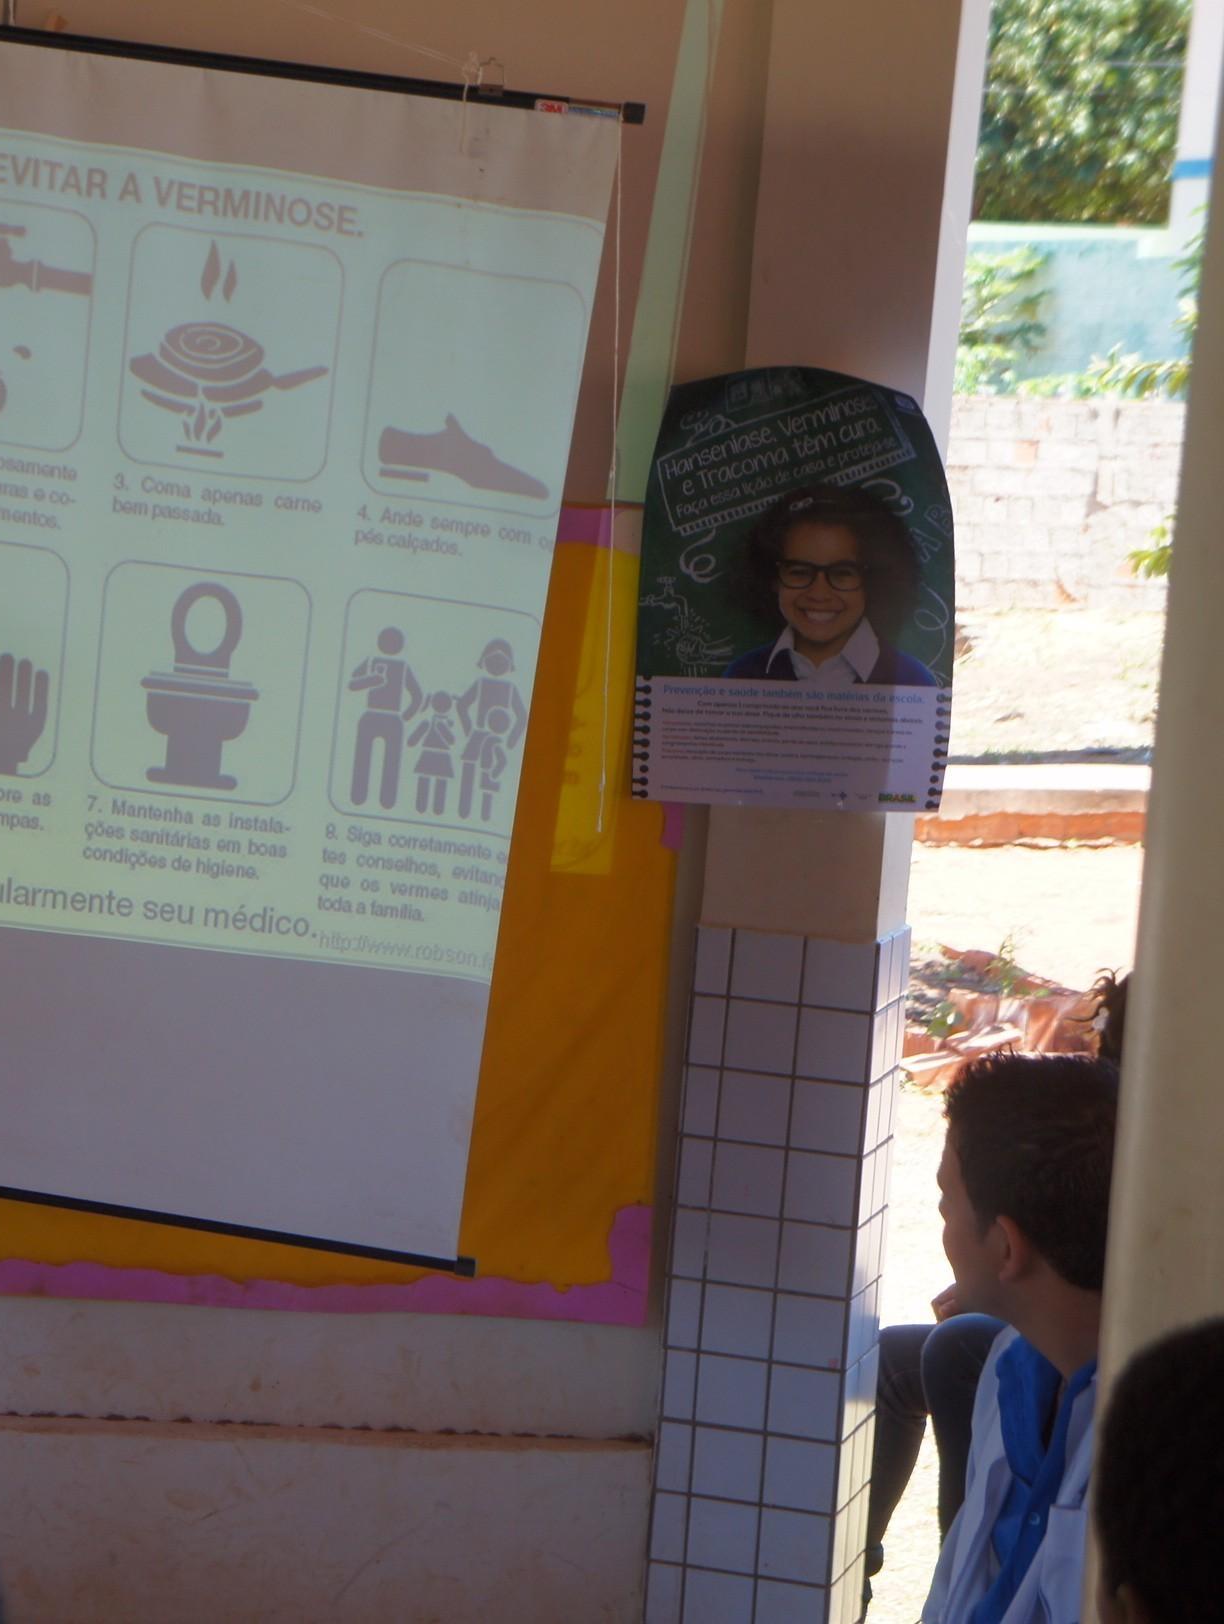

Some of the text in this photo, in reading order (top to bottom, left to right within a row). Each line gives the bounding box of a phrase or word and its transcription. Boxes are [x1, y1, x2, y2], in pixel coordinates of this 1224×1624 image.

[117, 173, 142, 204] A
[154, 176, 365, 238] VERMINOSE.
[682, 480, 695, 496] e
[697, 446, 790, 489] Tracoma
[793, 459, 826, 478] casa
[33, 488, 45, 501] e
[48, 489, 77, 506] co-
[113, 472, 323, 514] 3. Coma apenas carne
[112, 496, 225, 527] bem passada.
[356, 504, 371, 521] 4.
[380, 506, 424, 527] Ande
[430, 516, 491, 539] sempre
[498, 527, 532, 545] com
[354, 528, 464, 557] pés calçados.
[31, 791, 52, 807] as
[86, 794, 292, 834] 7. Mantenha as instala-
[84, 820, 287, 858] ções sanitárias em boas
[325, 822, 338, 840] 8.
[346, 825, 382, 847] Siga
[388, 833, 492, 860] corretamente
[82, 846, 260, 880] condições de higiene.
[322, 847, 346, 865] tes
[356, 853, 441, 879] conselhos,
[318, 873, 351, 891] que
[360, 877, 380, 893] os
[390, 881, 449, 901] vermes
[143, 898, 194, 926] seu
[203, 902, 318, 939] médico.
[317, 895, 425, 922] toda a família.
